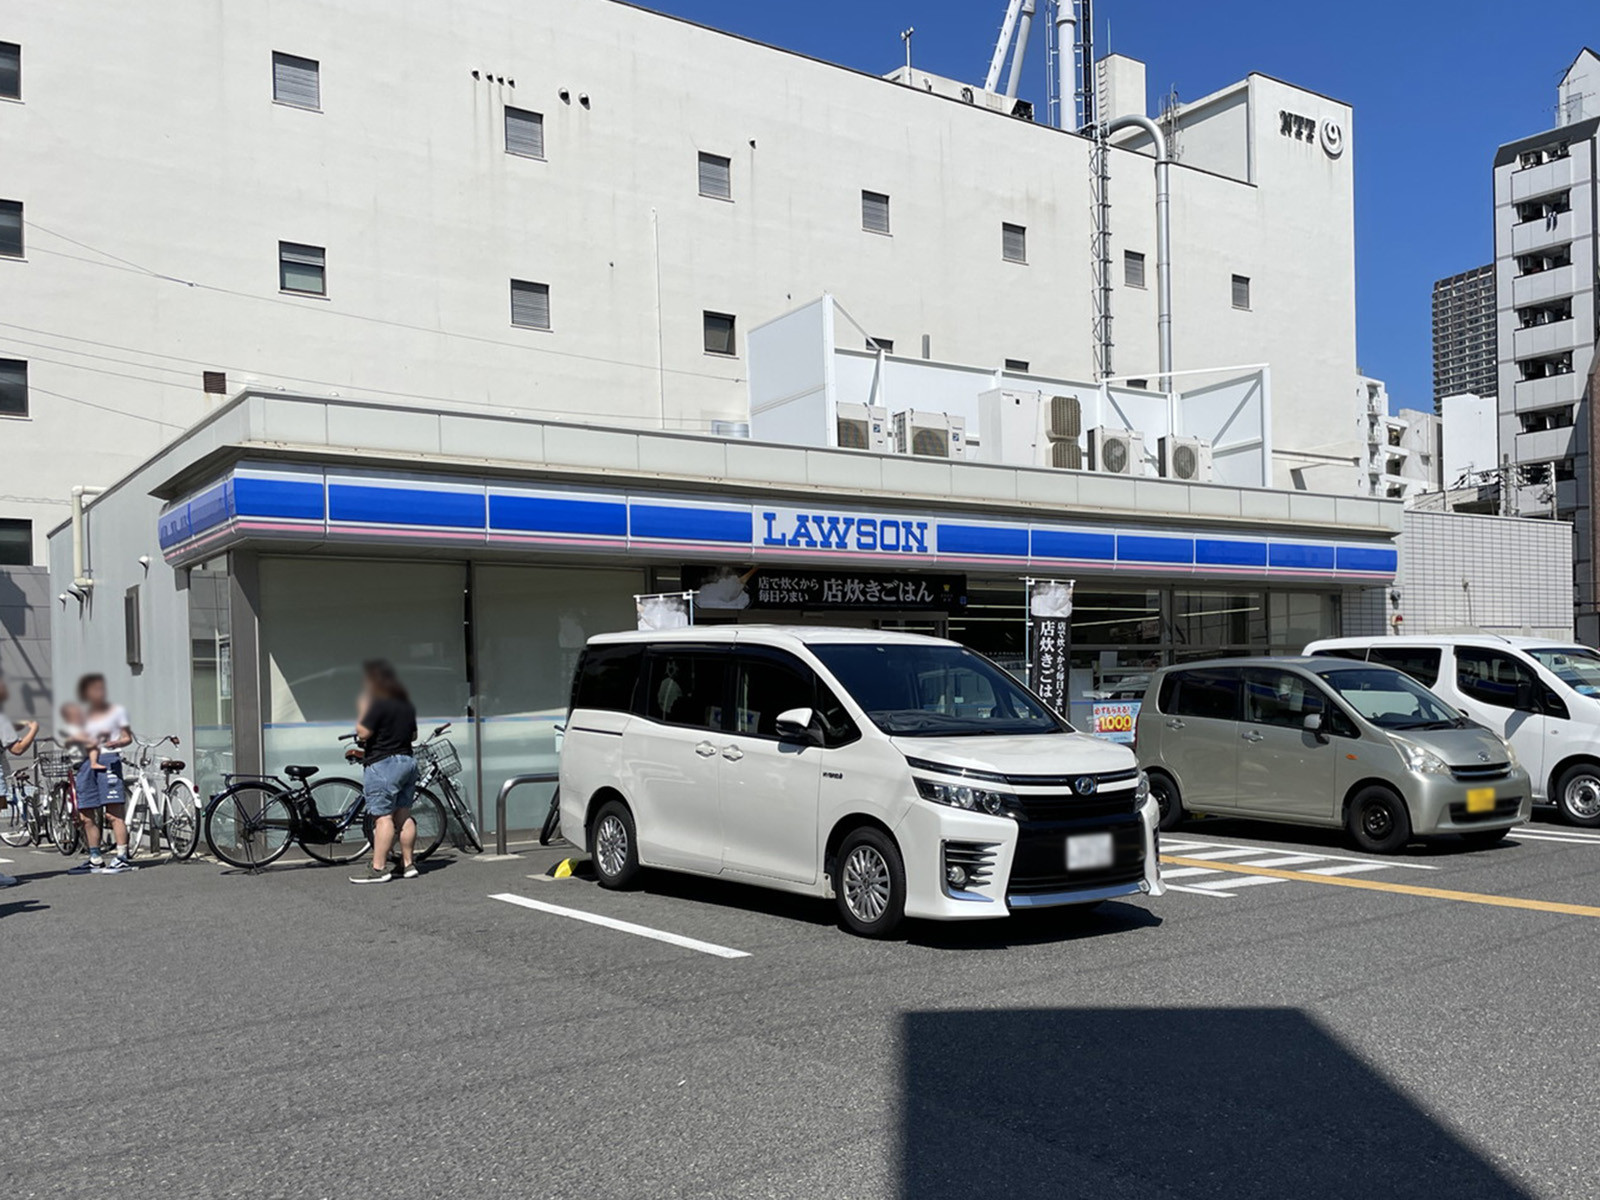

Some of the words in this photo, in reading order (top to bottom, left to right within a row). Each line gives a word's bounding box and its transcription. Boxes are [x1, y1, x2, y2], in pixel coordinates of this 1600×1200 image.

[1279, 110, 1316, 144] NTT
[763, 512, 928, 553] LAWSON
[758, 576, 819, 590] 店で炊くから
[758, 590, 809, 603] 毎日うまい
[822, 578, 934, 603] 店炊きごはん
[1039, 620, 1056, 704] 店炊きごは
